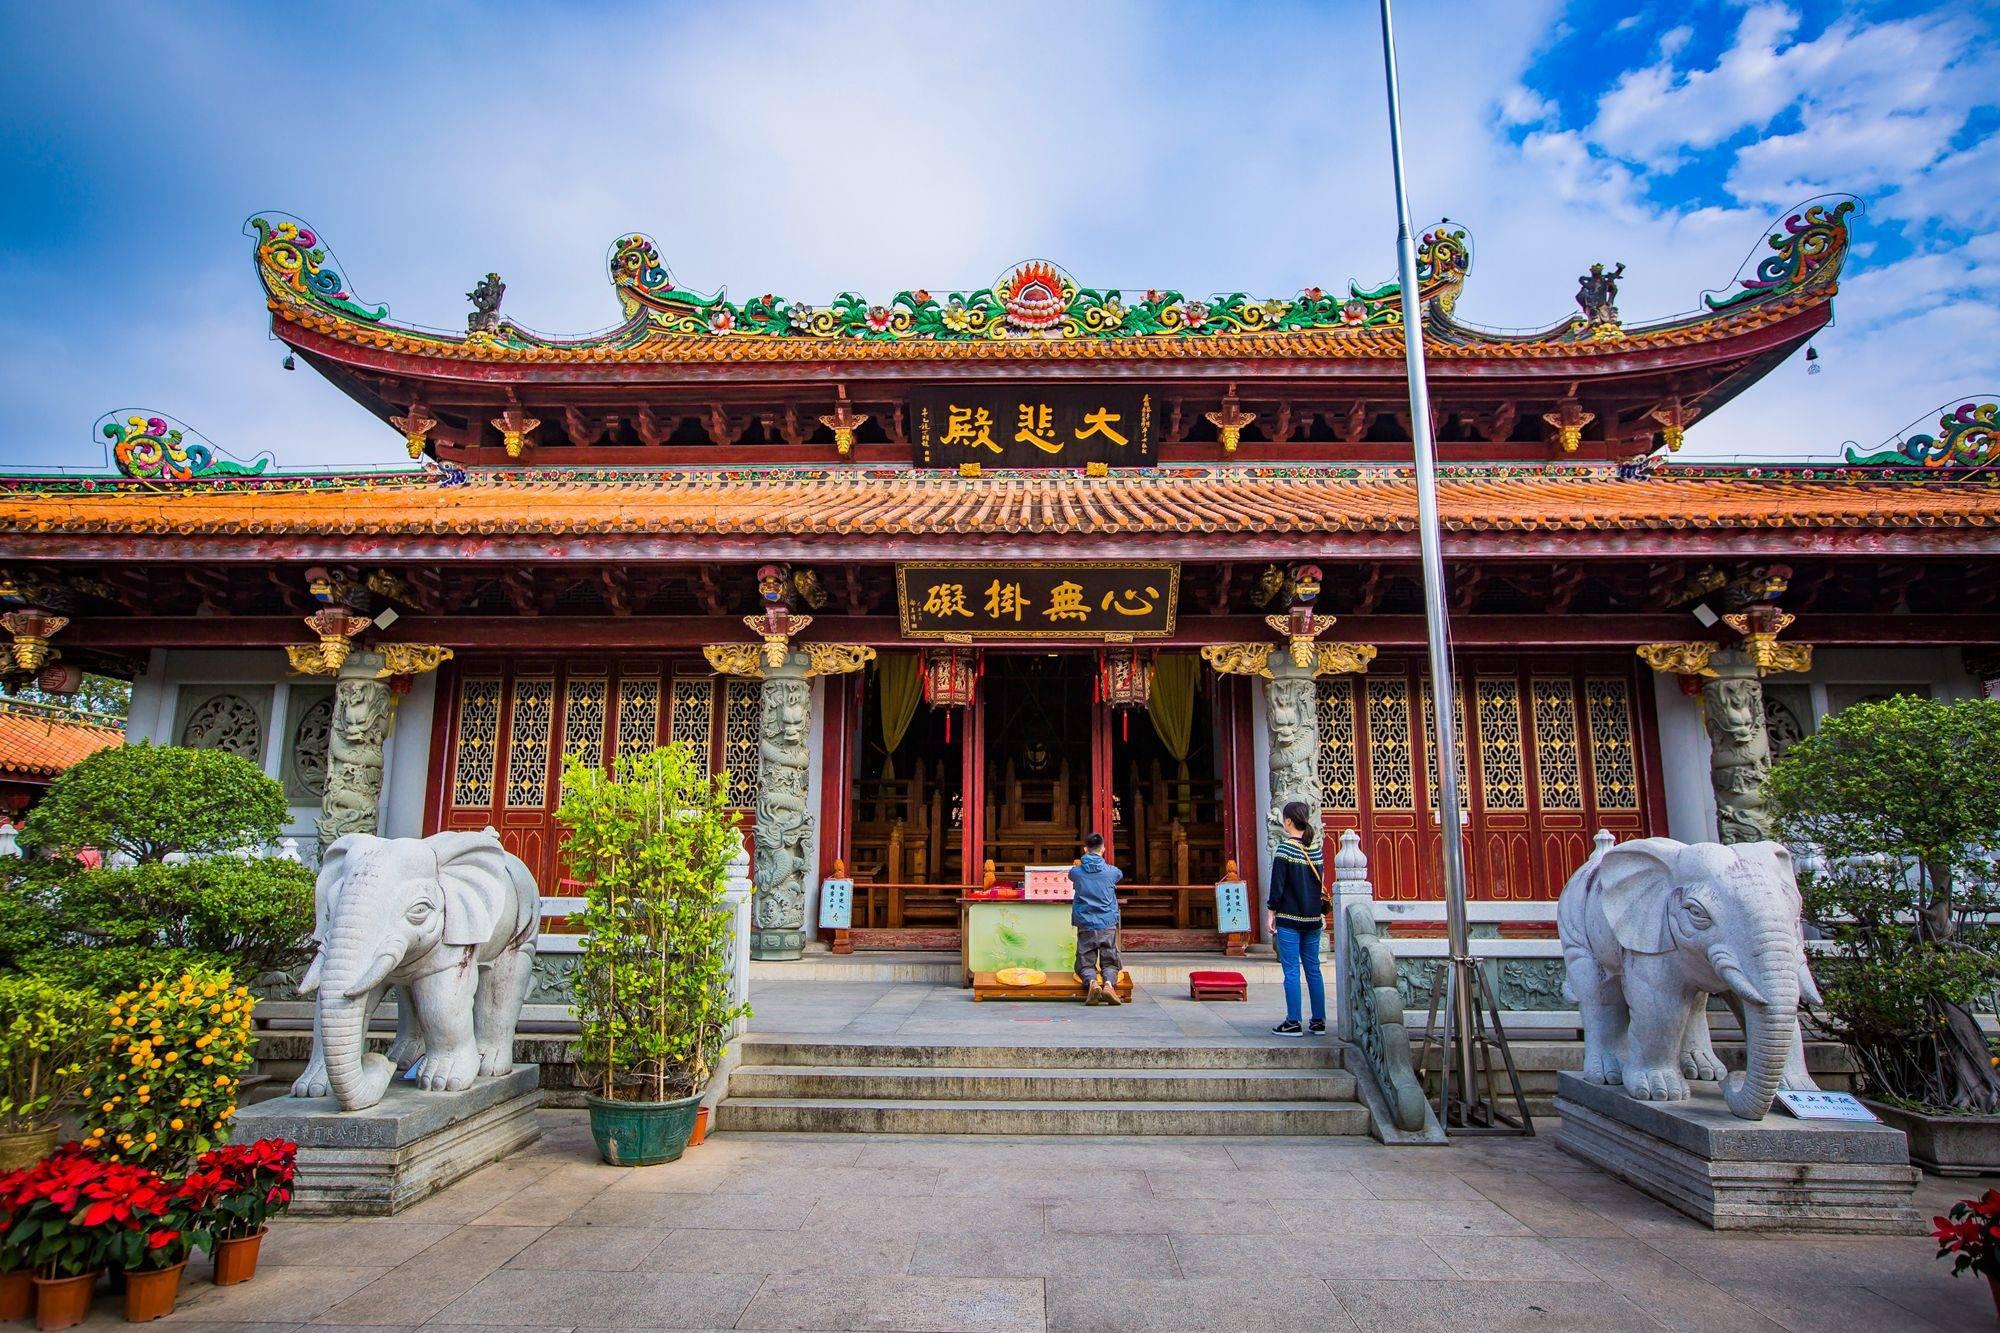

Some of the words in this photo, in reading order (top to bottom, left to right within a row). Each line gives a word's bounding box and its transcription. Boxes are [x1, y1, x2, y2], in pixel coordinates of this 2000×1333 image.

[939, 403, 1130, 455] 大悲殿
[922, 578, 1160, 622] 心無掛礙
